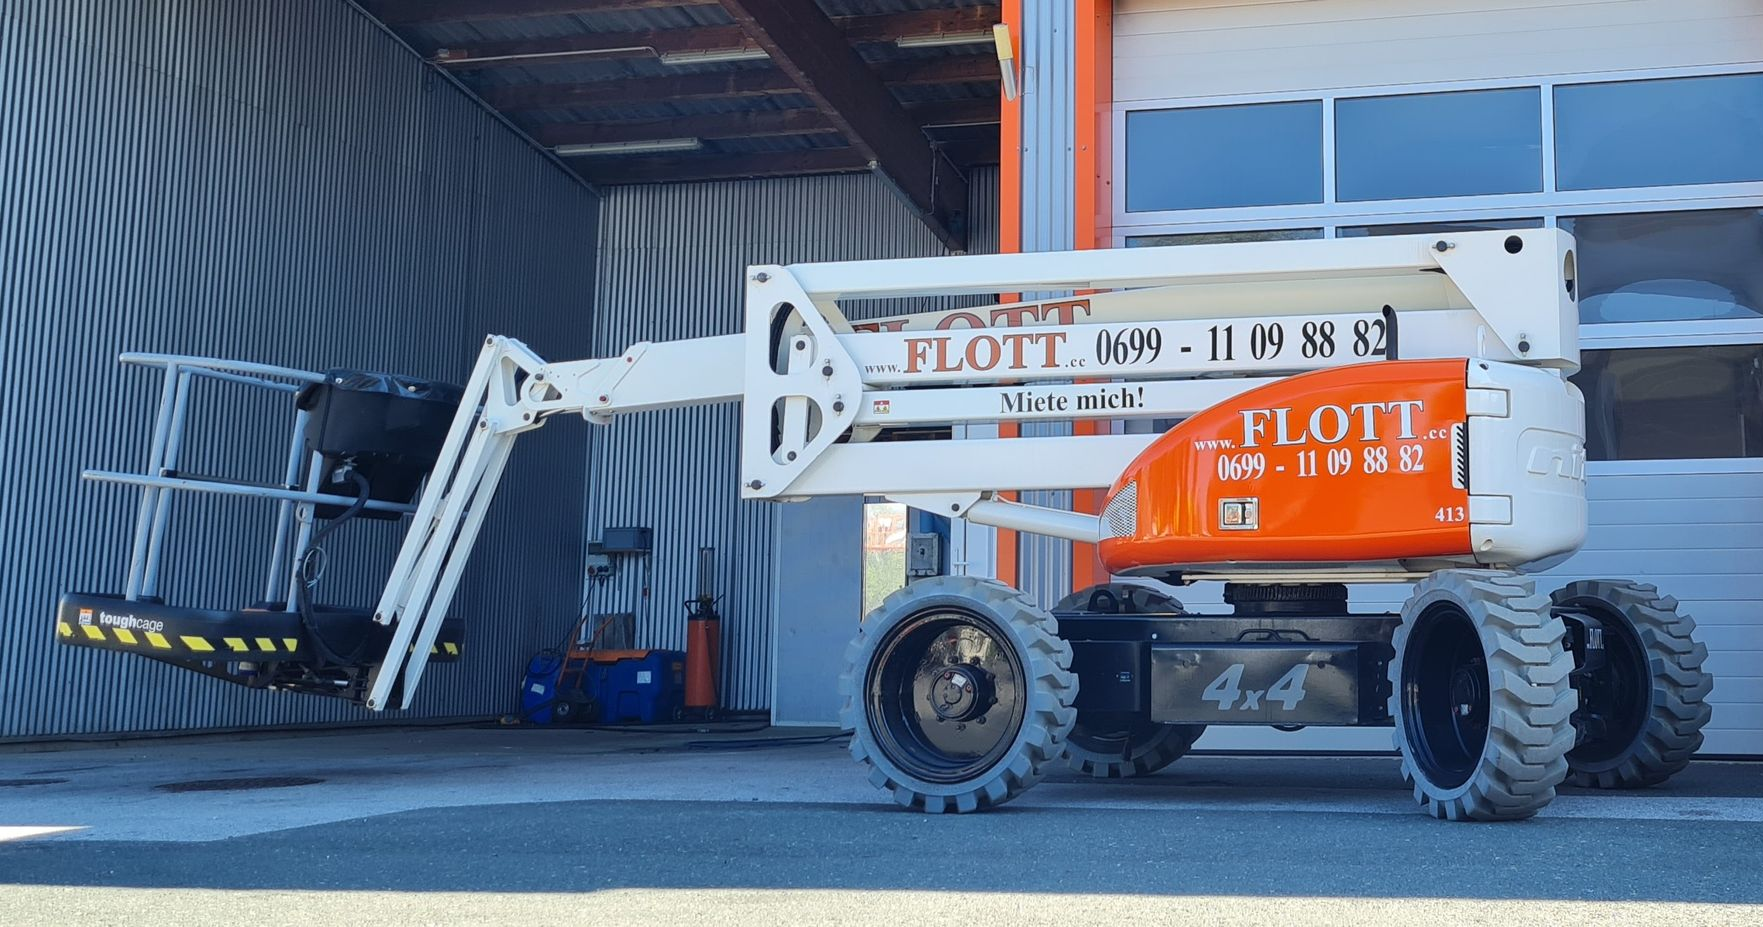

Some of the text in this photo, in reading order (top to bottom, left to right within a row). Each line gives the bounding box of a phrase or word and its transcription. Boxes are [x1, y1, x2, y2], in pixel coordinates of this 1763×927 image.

[1096, 327, 1162, 365] 0699
[1207, 324, 1236, 361] 11
[1250, 322, 1284, 360] 09
[1301, 321, 1336, 358] 88
[1353, 319, 1386, 356] 82
[1000, 386, 1144, 413] Miete mich!
[1217, 452, 1265, 481] 0699
[1296, 450, 1318, 477] 11
[1327, 448, 1352, 475] 09
[1363, 446, 1388, 474] 88
[1399, 444, 1425, 472] 82
[1434, 506, 1465, 522] 413
[99, 611, 164, 633] toughcage
[1201, 663, 1309, 711] 4x4
